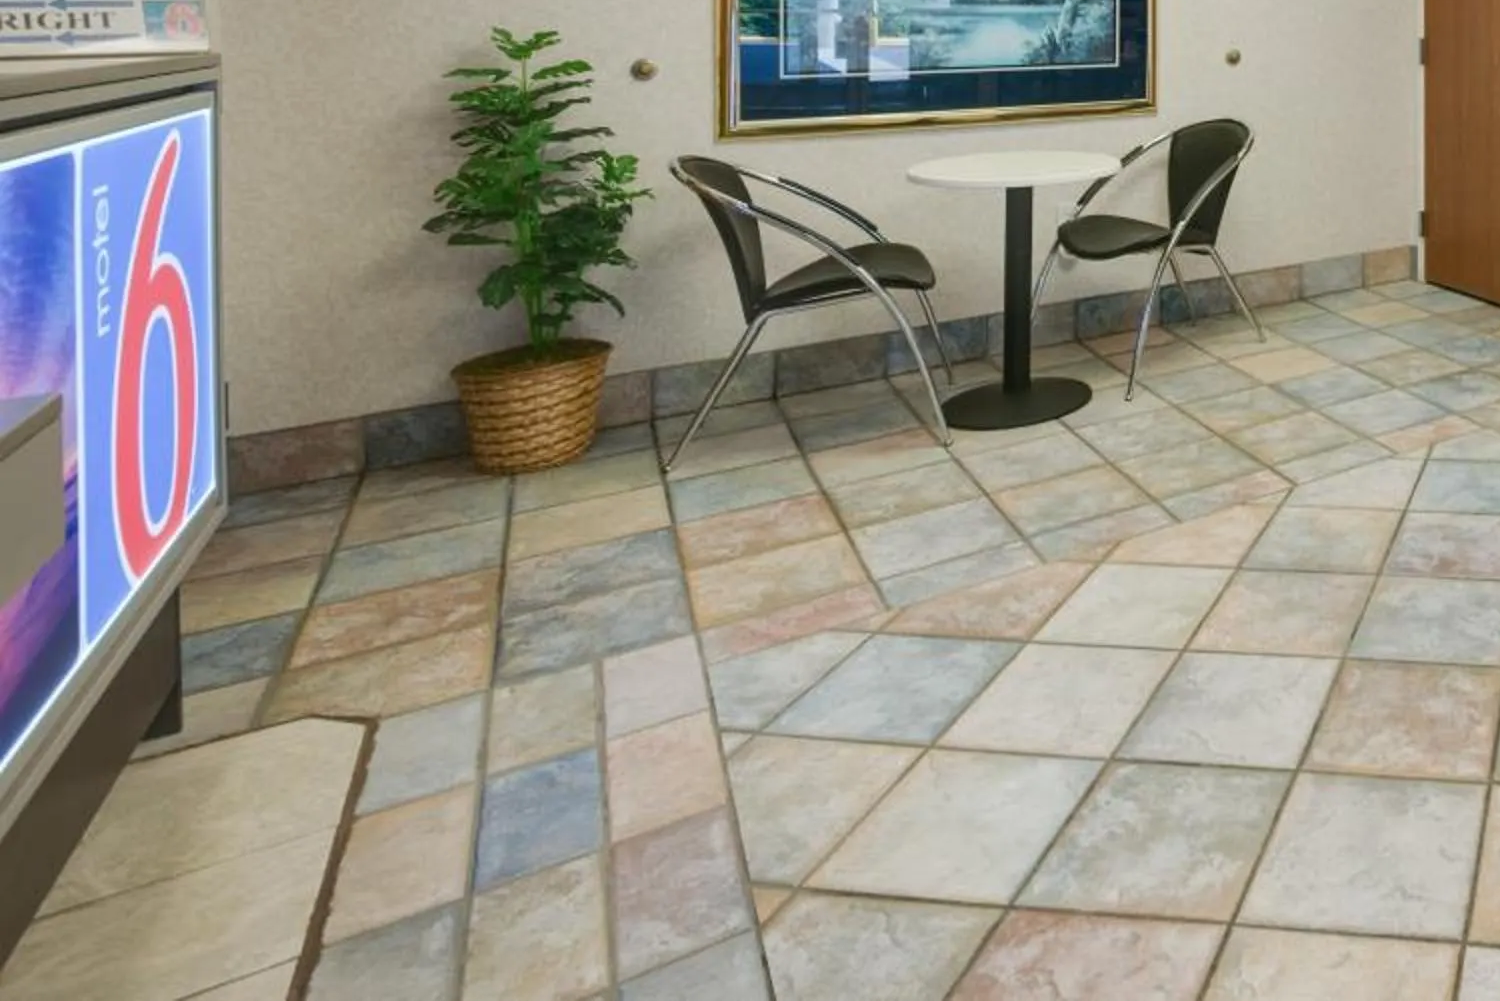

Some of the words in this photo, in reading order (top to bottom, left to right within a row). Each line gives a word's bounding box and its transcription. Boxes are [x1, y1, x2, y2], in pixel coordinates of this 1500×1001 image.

[0, 11, 117, 30] RIGHT
[93, 184, 111, 337] motel
[111, 128, 198, 589] 6
